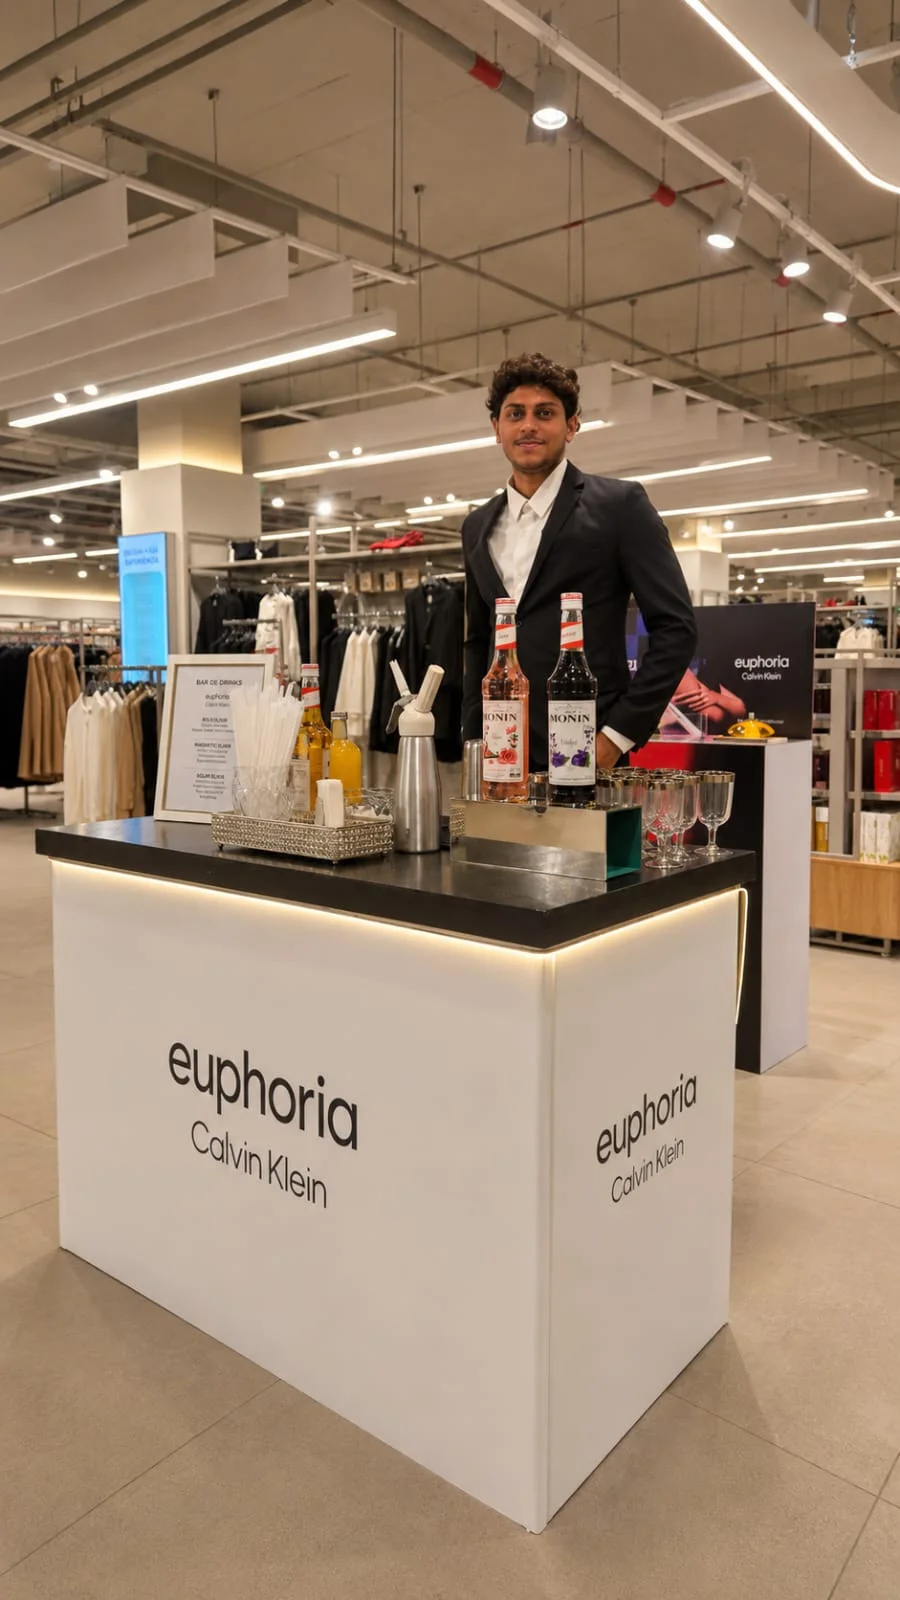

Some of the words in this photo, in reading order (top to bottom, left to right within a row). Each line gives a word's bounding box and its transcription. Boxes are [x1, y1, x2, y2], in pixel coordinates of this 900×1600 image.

[734, 655, 789, 671] euphoria
[550, 713, 590, 722] MONIN
[168, 1042, 358, 1151] euphoria
[596, 1072, 697, 1165] euphoria
[191, 1120, 263, 1180] Calvin
[268, 1149, 327, 1209] Klein
[611, 1159, 654, 1204] Calvin
[655, 1138, 685, 1173] Klein
